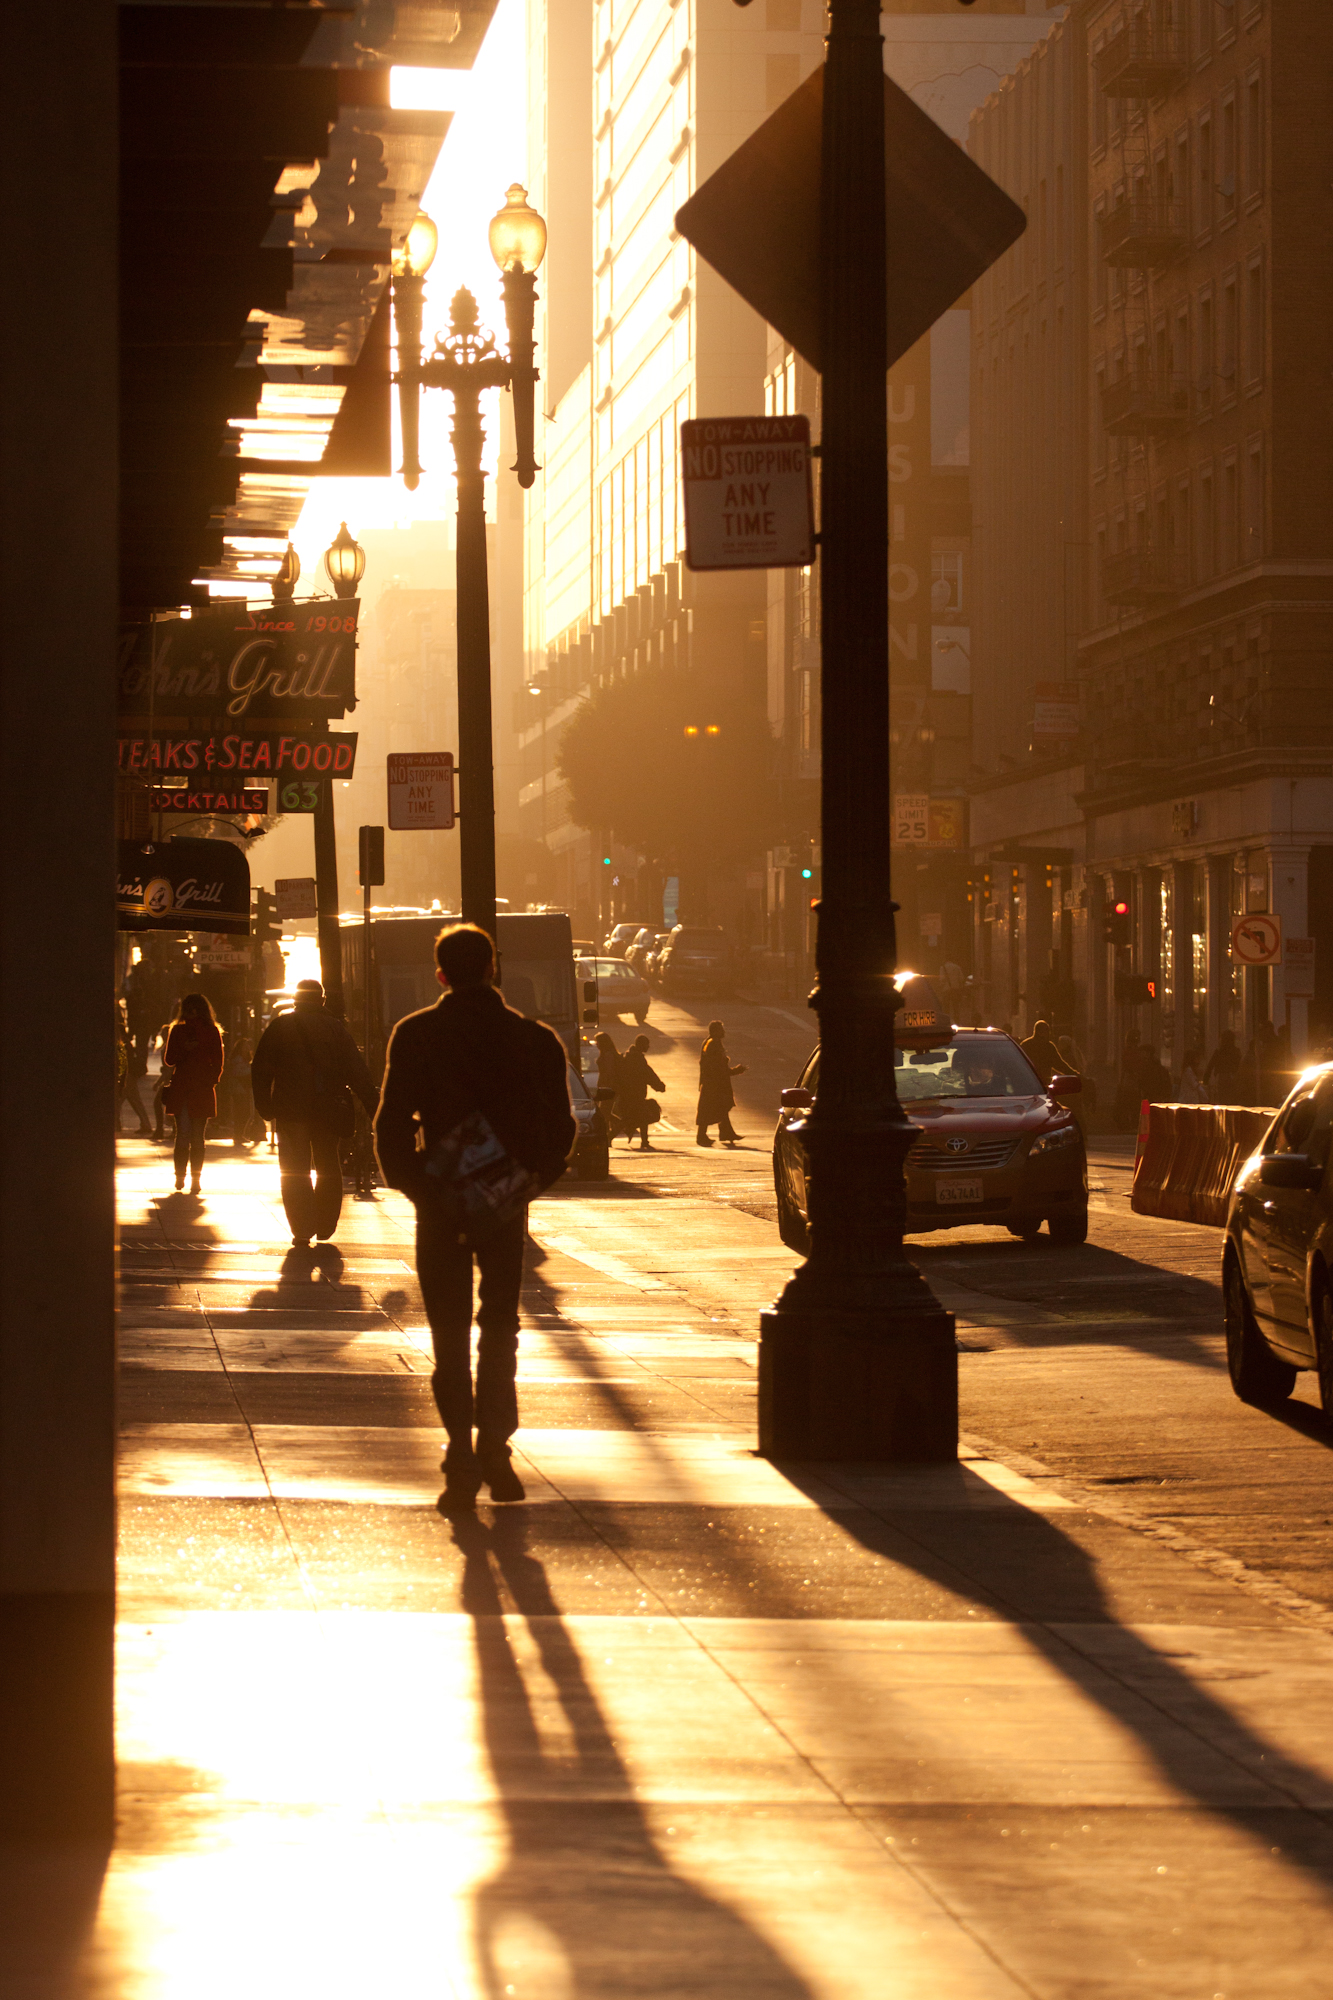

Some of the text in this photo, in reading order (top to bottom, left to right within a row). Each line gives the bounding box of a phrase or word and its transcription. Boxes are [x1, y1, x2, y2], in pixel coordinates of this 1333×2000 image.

[693, 422, 796, 441] TOW-AWAY
[685, 444, 804, 478] NO STOPPING
[724, 482, 771, 508] ANY
[722, 511, 777, 537] TIME
[234, 612, 356, 633] Since 1908
[226, 638, 343, 716] Grill
[116, 738, 203, 770] TEAKS
[204, 737, 217, 771] &
[393, 756, 446, 765] TOW-AWAY
[390, 766, 449, 783] NO STOPPING
[150, 791, 264, 811] OCKTAILS
[281, 781, 320, 810] 63
[409, 786, 432, 798] ANY
[407, 801, 435, 813] TIME
[897, 799, 926, 807] SPEED
[899, 810, 924, 819] LIMIT
[898, 822, 926, 838] 25
[175, 878, 225, 908] Grill
[903, 1010, 936, 1026] FOR HIRE
